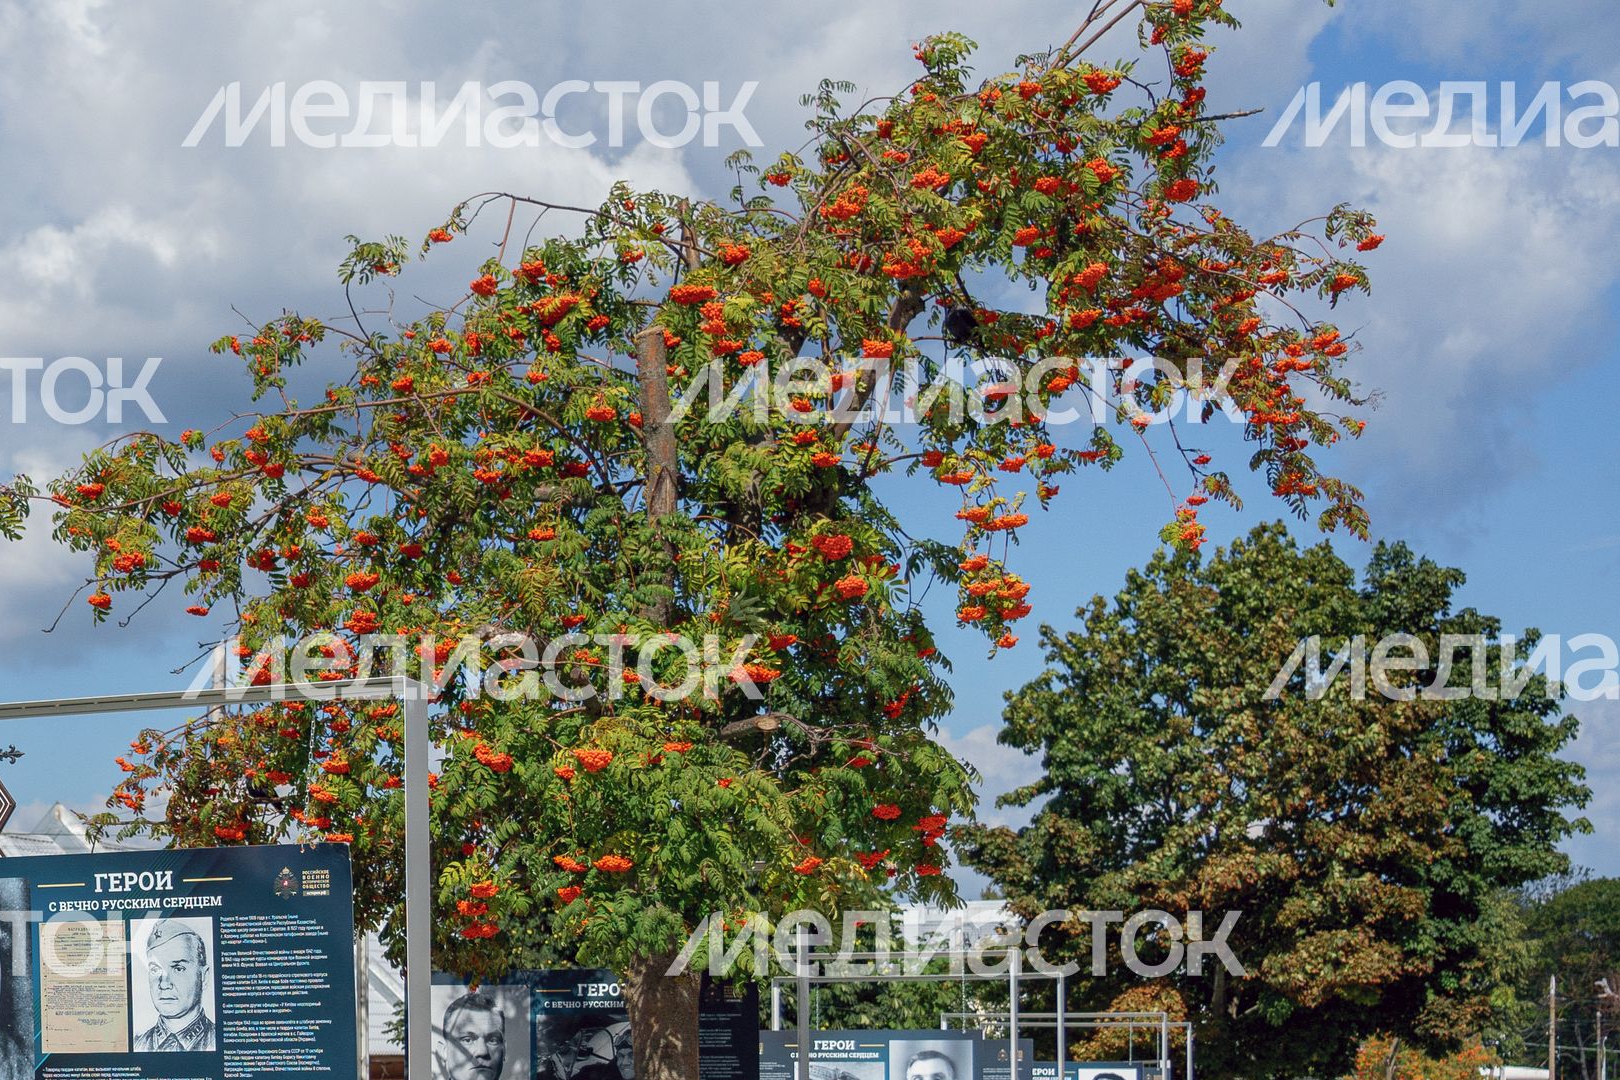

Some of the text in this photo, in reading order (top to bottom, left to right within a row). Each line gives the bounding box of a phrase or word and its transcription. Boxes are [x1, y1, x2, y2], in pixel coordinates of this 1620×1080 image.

[94, 870, 173, 893] ГЕРОИ
[48, 896, 222, 913] С ВЕЧНО РУССКИМ СЕРДЦЕМ
[577, 983, 626, 997] ГЕРО
[814, 1040, 855, 1050] ГЕРОИ
